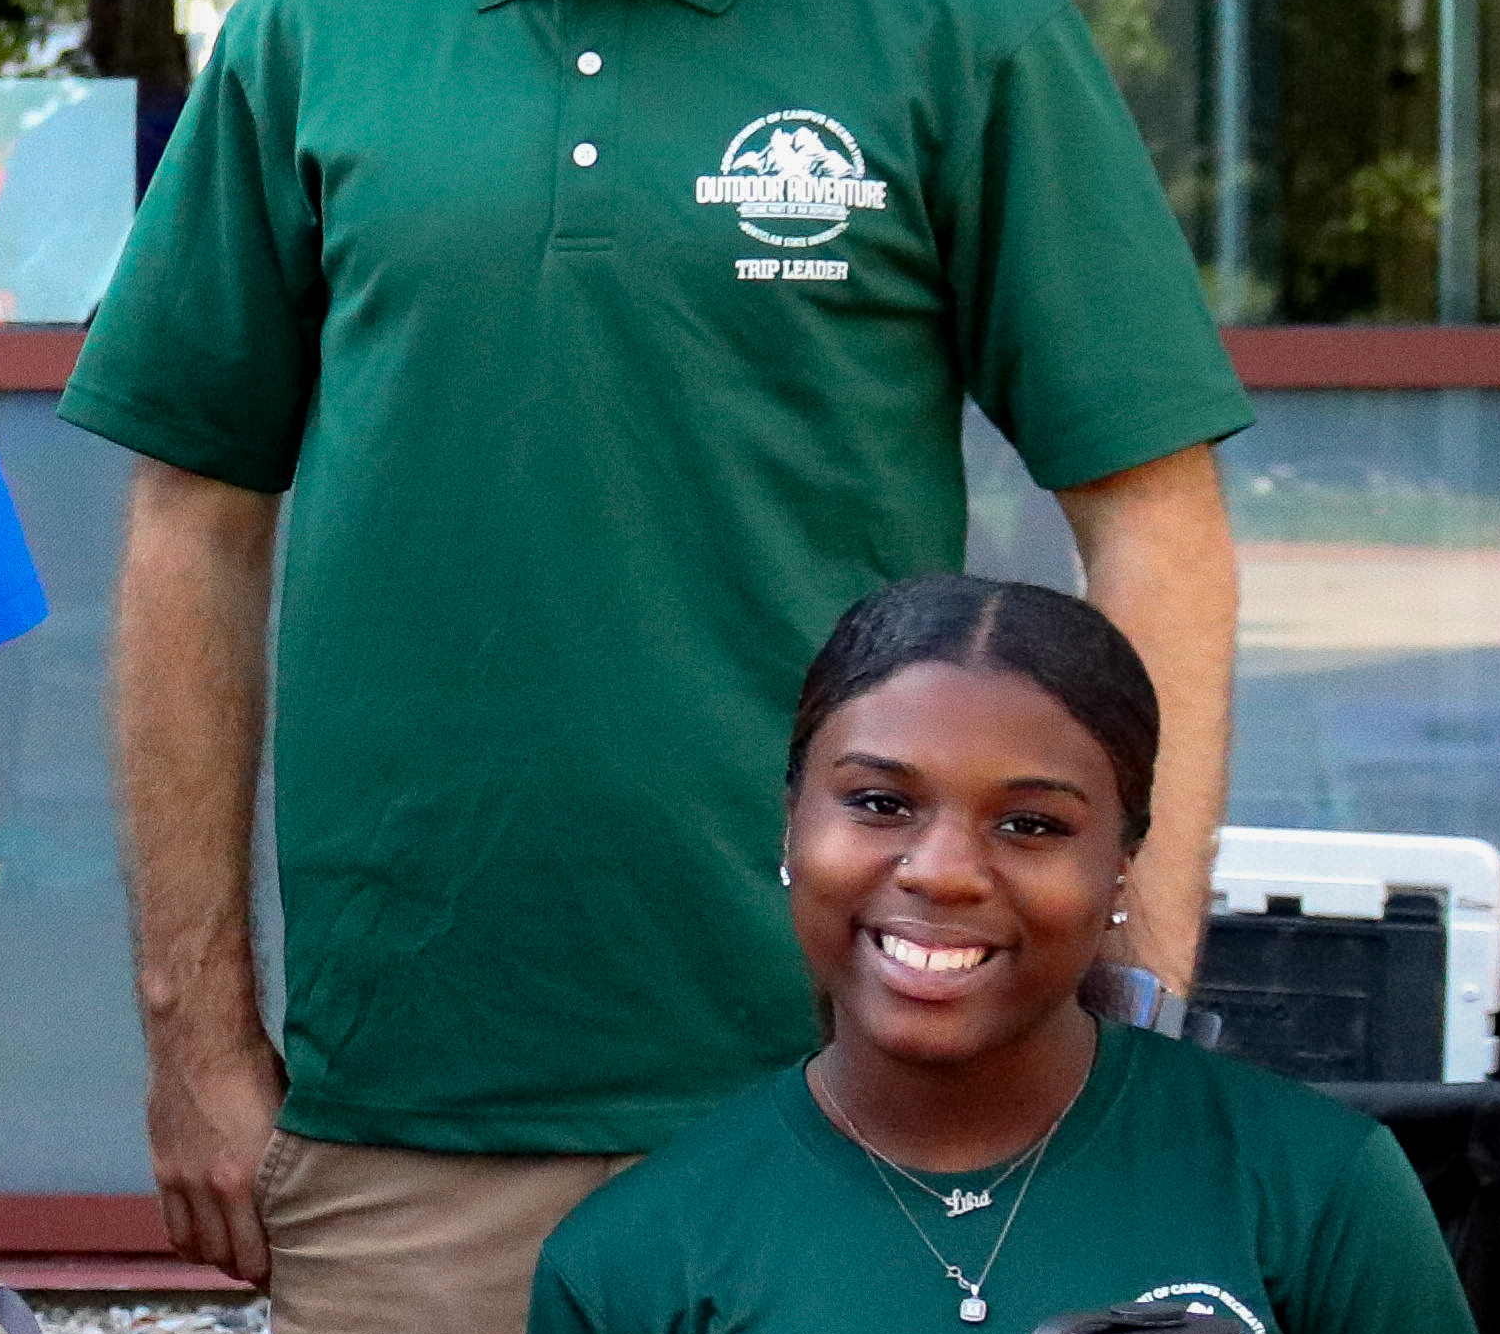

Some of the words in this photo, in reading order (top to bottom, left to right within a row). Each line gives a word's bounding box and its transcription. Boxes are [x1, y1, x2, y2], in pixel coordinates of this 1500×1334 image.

[696, 175, 784, 204] OUTDOOR
[786, 176, 887, 209] ADVENTURE
[735, 259, 780, 280] TRIP
[781, 259, 849, 280] LEADER
[1170, 1283, 1220, 1297] CAMPUS
